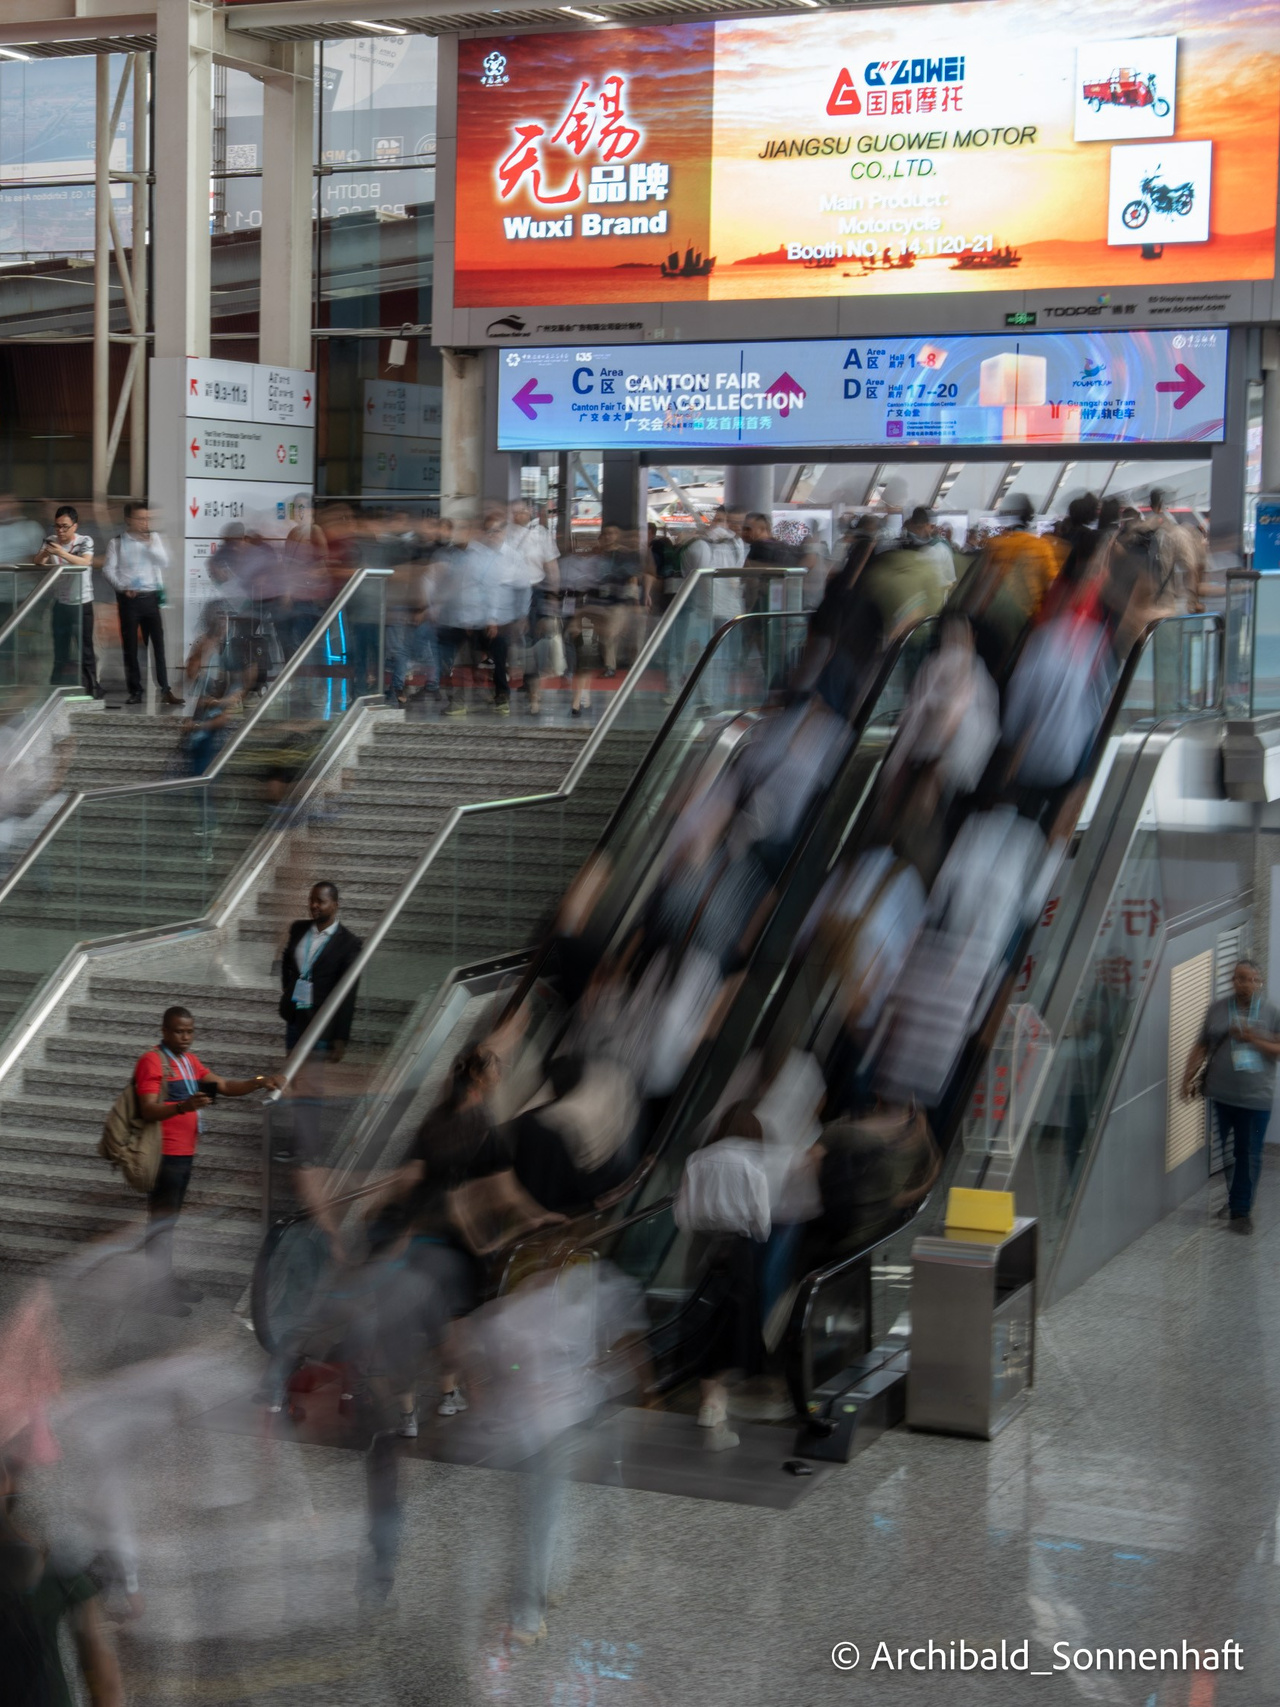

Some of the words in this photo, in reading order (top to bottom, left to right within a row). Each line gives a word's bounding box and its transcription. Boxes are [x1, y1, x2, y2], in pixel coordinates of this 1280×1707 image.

[866, 86, 963, 116] 国威摩托
[759, 137, 851, 159] JIANGSU
[857, 131, 948, 153] GUOWEI
[952, 125, 1037, 147] MOTOR
[851, 158, 937, 181] CO.,LTD.
[588, 162, 669, 203] 品牌
[820, 193, 864, 212] Main
[503, 214, 573, 240] Wuxi
[581, 210, 668, 237] Brand
[838, 215, 942, 236] Motorcycle
[787, 241, 843, 260] Booth
[843, 348, 862, 369] A
[867, 356, 878, 369] 区
[572, 366, 594, 395] C
[600, 368, 624, 377] Area
[601, 378, 615, 395] 区
[625, 372, 710, 392] CANTON
[715, 371, 761, 390] FAIR
[843, 379, 861, 399] D
[624, 394, 672, 413] NEW
[676, 391, 804, 412] COLLECTION
[866, 386, 878, 399] 区
[572, 403, 598, 412] Canton
[600, 402, 615, 411] Fair
